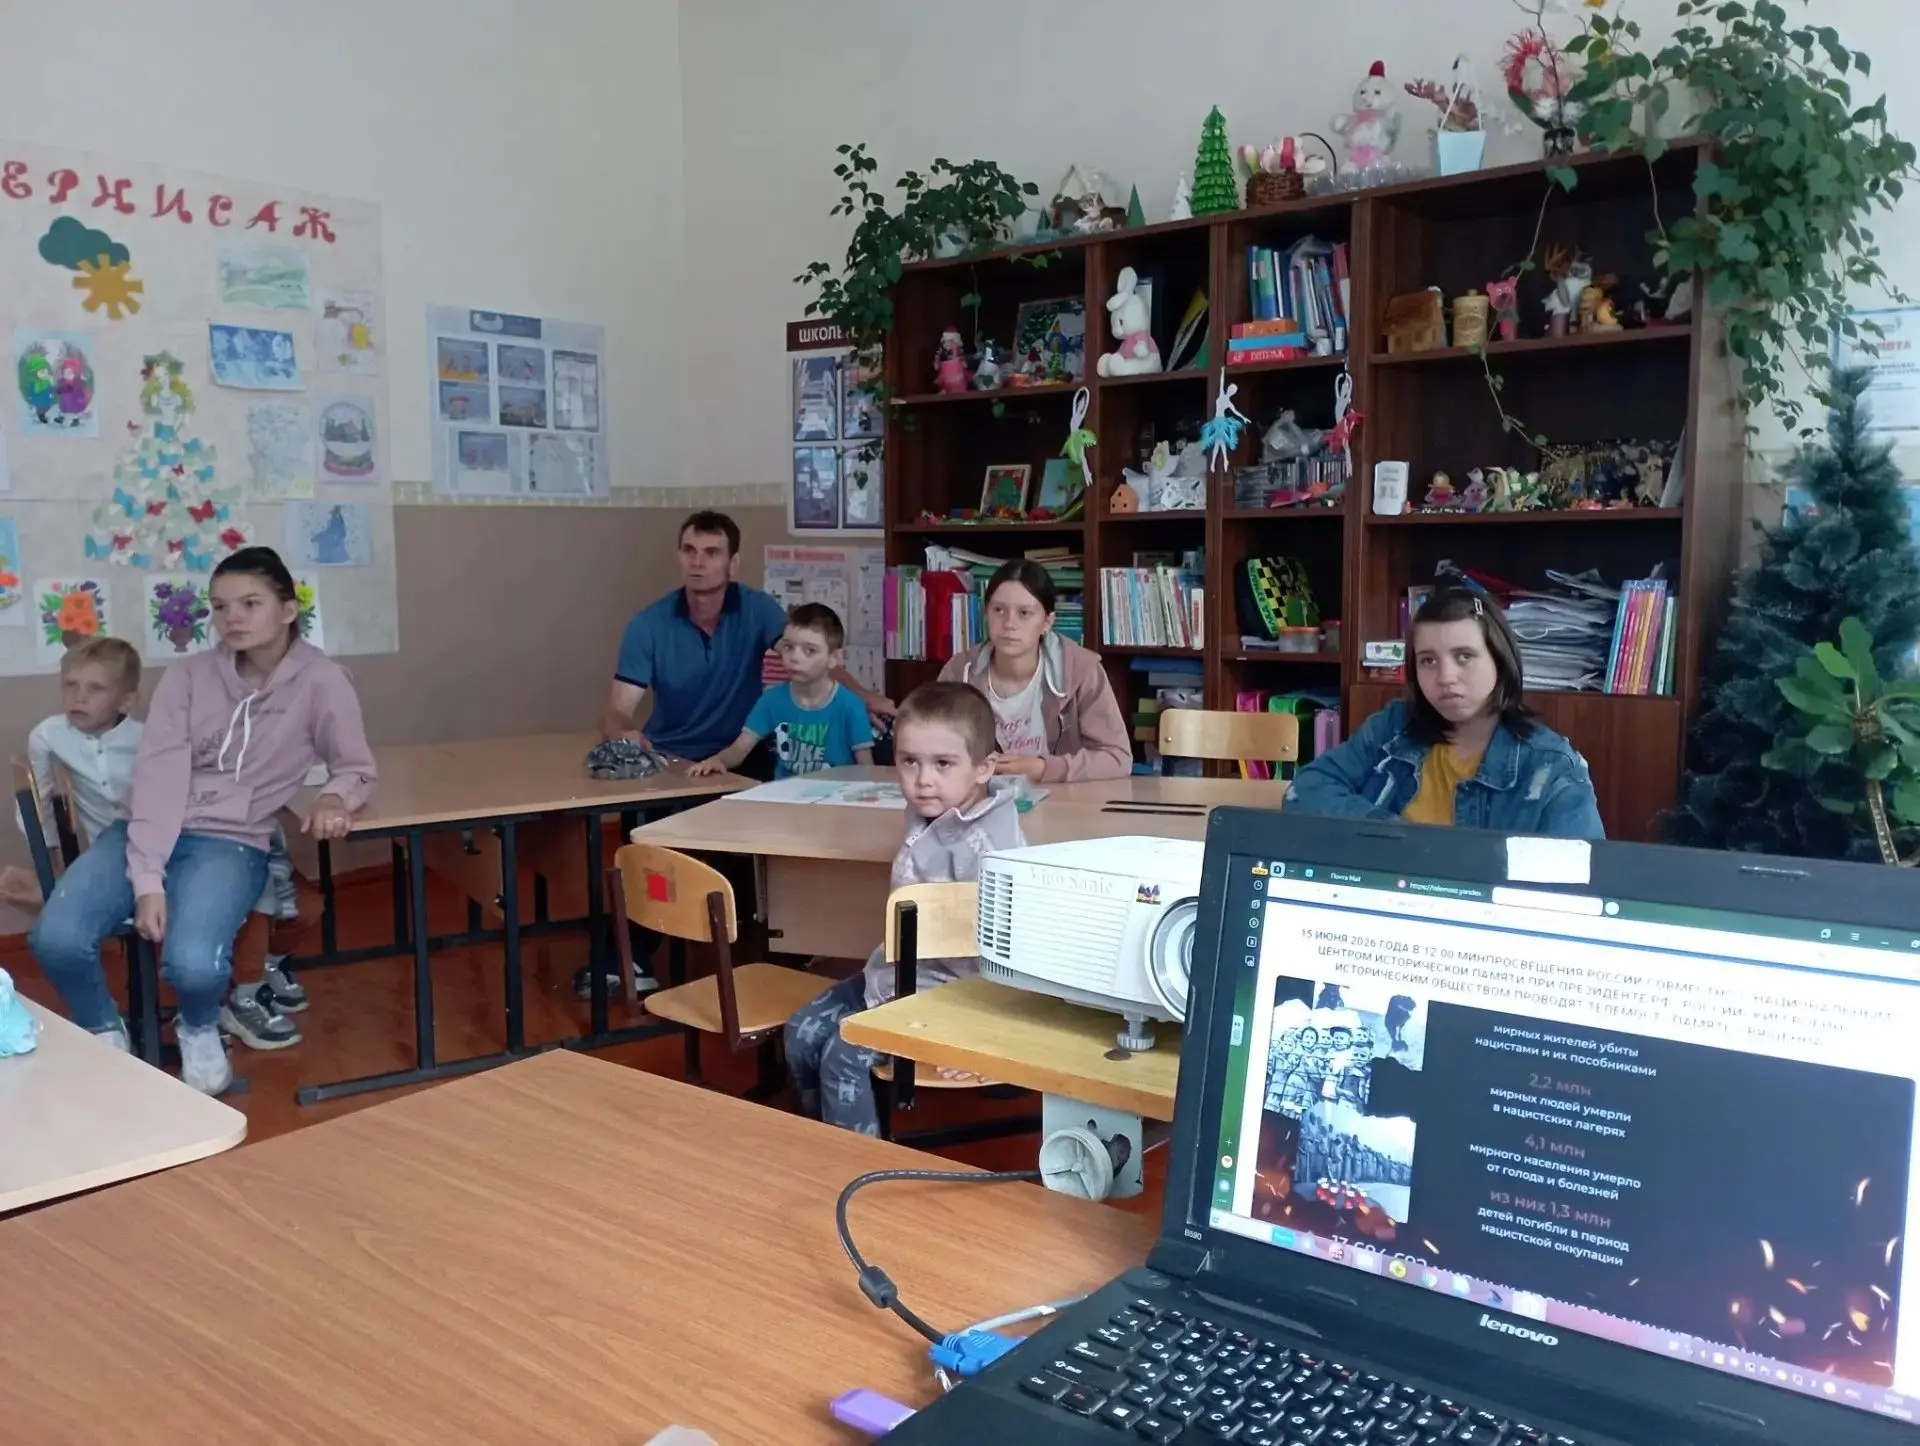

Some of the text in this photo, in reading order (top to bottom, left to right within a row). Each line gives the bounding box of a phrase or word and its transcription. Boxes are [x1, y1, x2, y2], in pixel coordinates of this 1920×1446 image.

[798, 325, 859, 343] ШКОЛЬ
[1314, 930, 1349, 944] ИЮНЯ
[1379, 939, 1409, 953] ГОДА
[1412, 943, 1420, 954] В
[1317, 945, 1372, 963] ЦЕНТРОМ
[1472, 966, 1526, 985] ПАМЯТИ
[1528, 976, 1555, 990] ПРИ
[1559, 980, 1648, 1004] ПРЕЗИДЕНТЕ
[1335, 962, 1429, 986] ИСТОРИЧЕСКИМ
[1431, 977, 1510, 998] ОБЩЕСТВОМ
[1513, 989, 1584, 1010] ПРОВОДЯТ
[1475, 1037, 1657, 1077] нацистами и их пособниками
[1493, 1024, 1639, 1058] мирных жителей убиты
[1490, 1087, 1632, 1123] мирных людей умерли
[1556, 1080, 1592, 1097] млн
[1493, 1103, 1626, 1138] в нацистских лагерях
[1524, 1133, 1586, 1160] 4,1 млн
[1469, 1143, 1642, 1190] мирного населения умерло
[1486, 1163, 1620, 1201] от голода и болезней
[1490, 1190, 1612, 1230] из них 1,3 млн
[1184, 1228, 1202, 1241] B590
[1477, 1207, 1630, 1253] детей погибли в период
[1480, 1223, 1624, 1267] нацистской оккупации
[1479, 1313, 1559, 1347] lenovo
